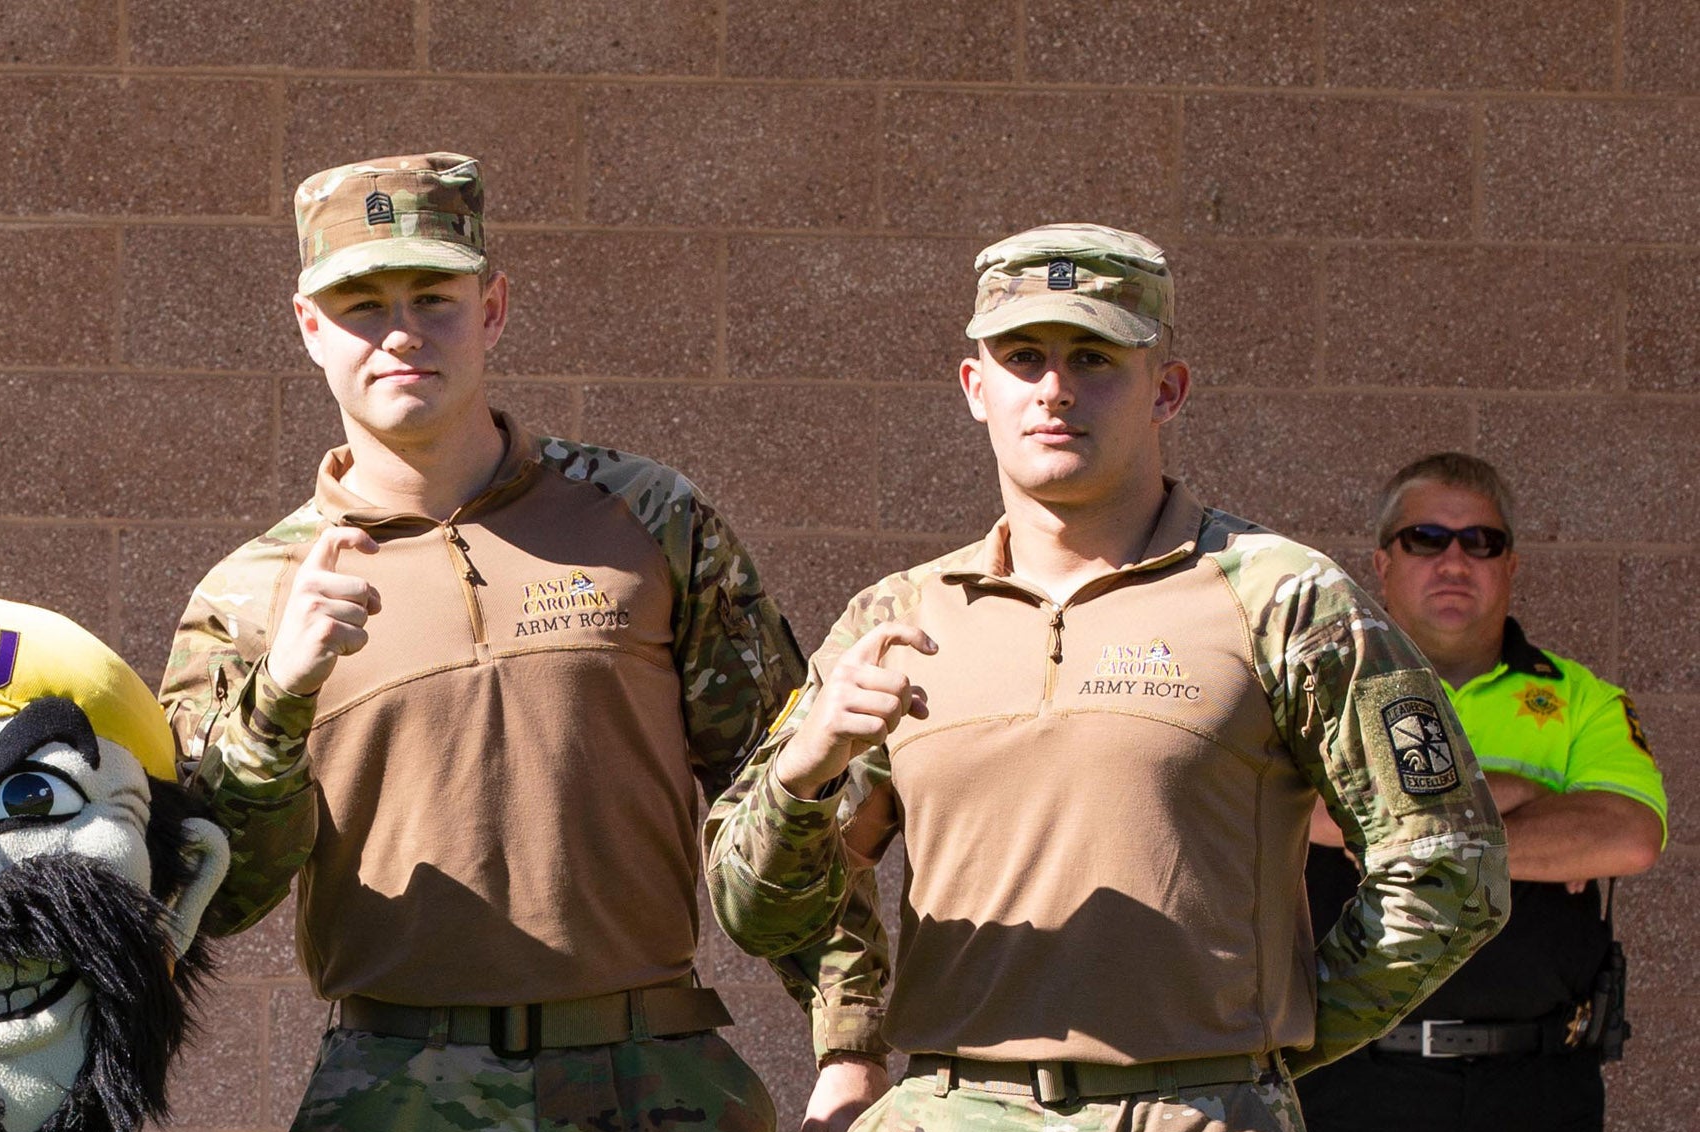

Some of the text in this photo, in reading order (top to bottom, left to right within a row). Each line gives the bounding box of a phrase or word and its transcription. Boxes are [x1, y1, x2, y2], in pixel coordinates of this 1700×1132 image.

[522, 577, 567, 600] EAST
[522, 591, 613, 616] CAROLINA
[515, 610, 629, 637] ARMY ROTC
[1101, 645, 1145, 661] EAST
[1095, 660, 1183, 679] CAROLINA
[1079, 680, 1200, 700] ARMY ROTC
